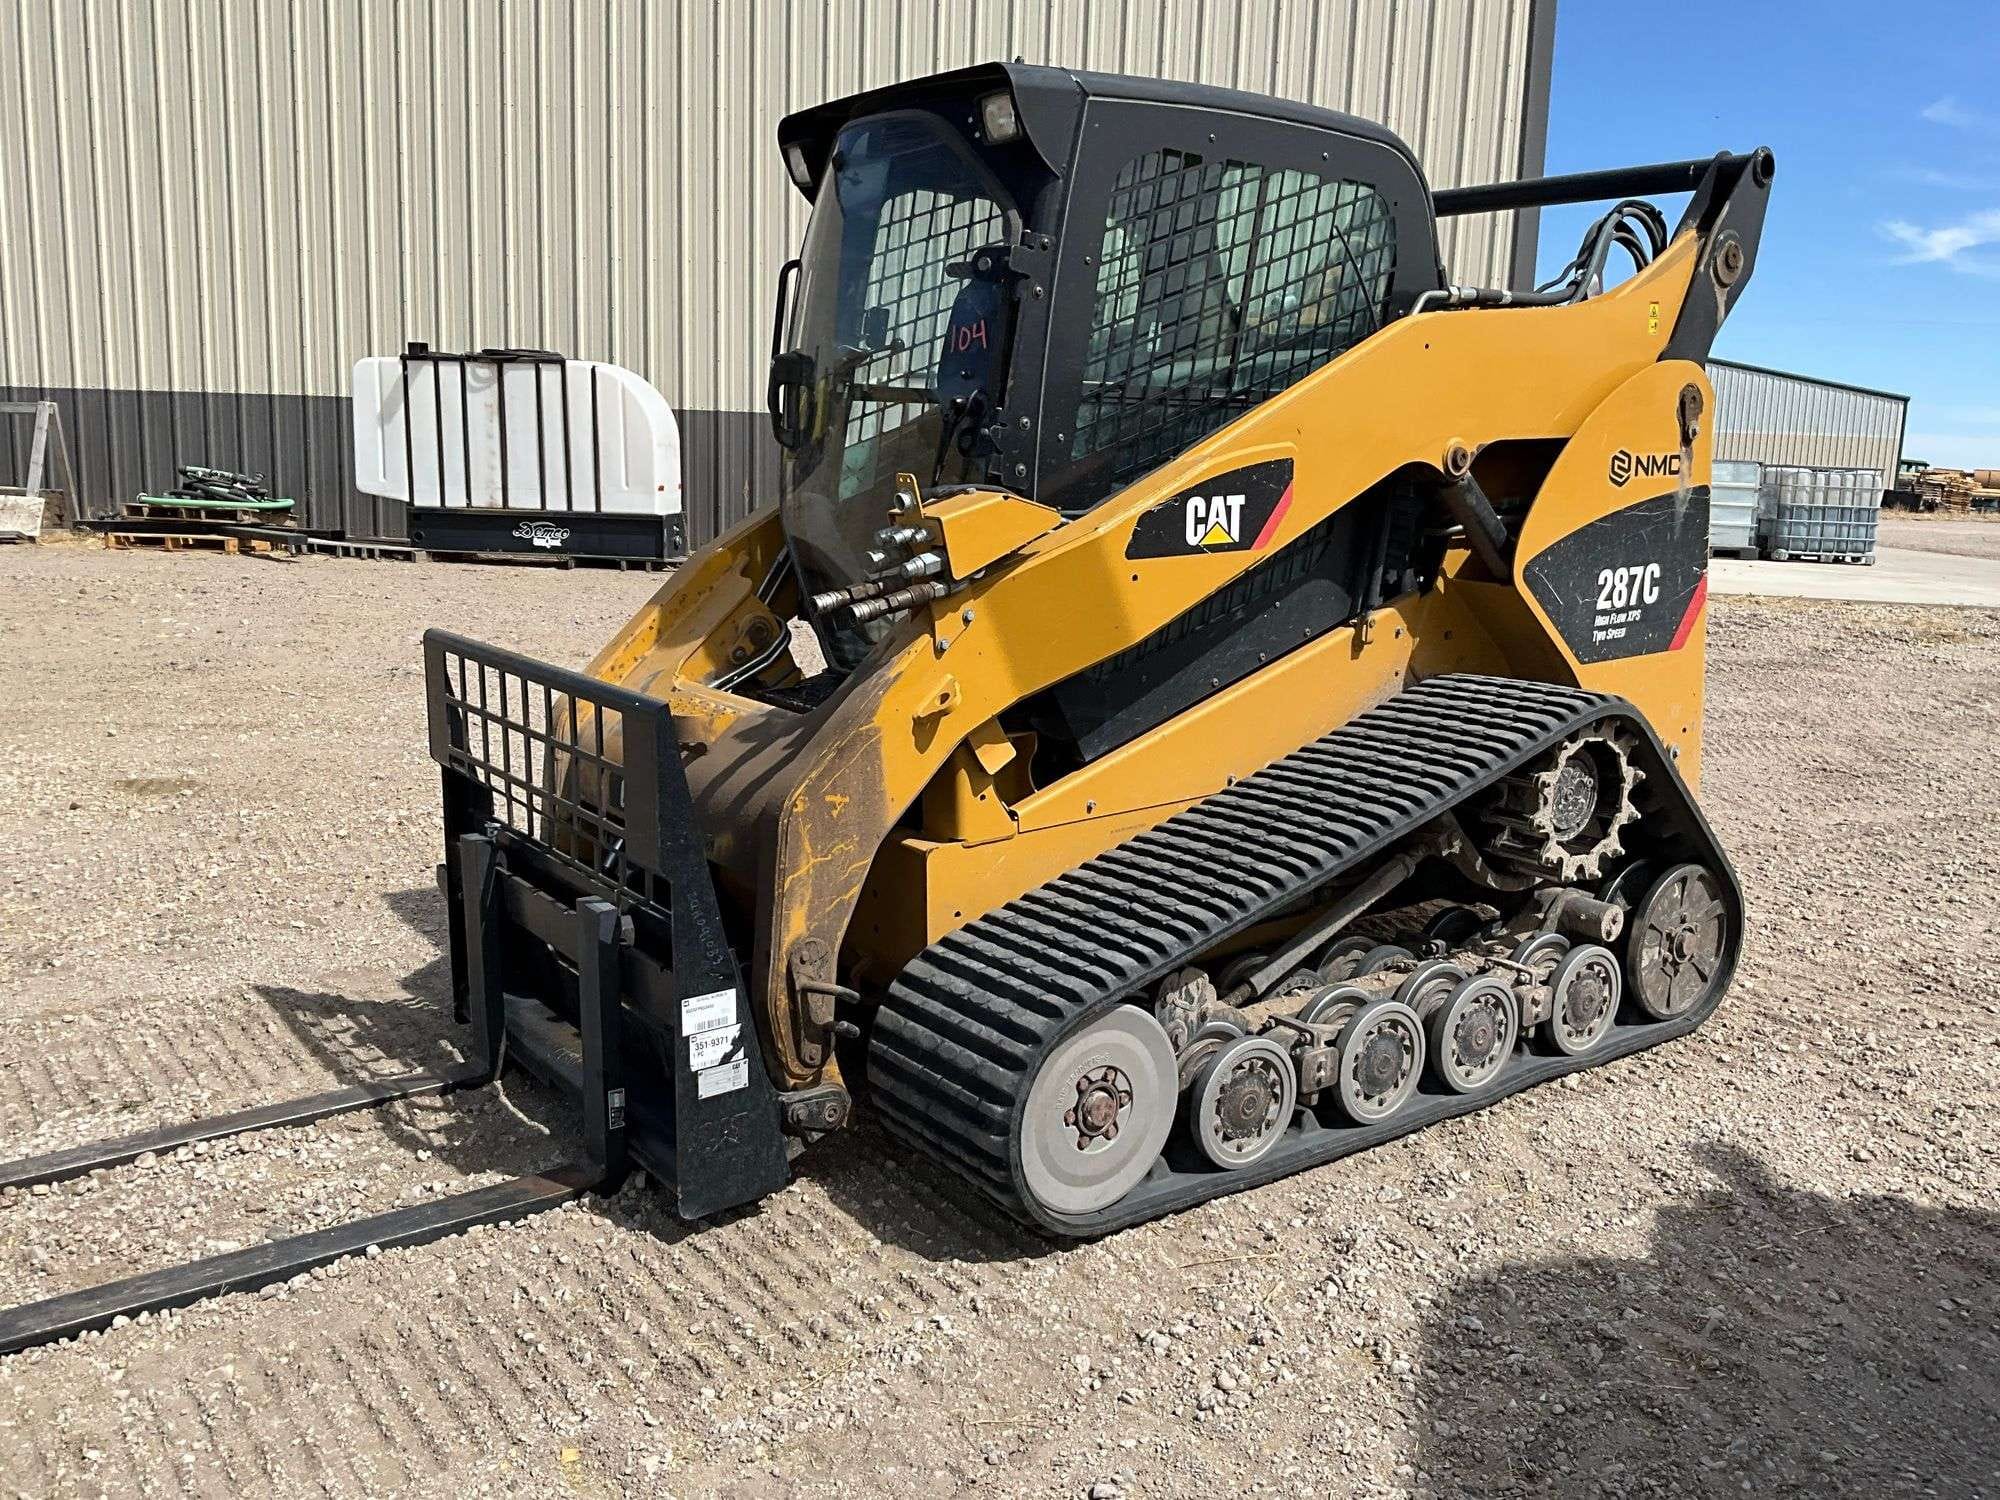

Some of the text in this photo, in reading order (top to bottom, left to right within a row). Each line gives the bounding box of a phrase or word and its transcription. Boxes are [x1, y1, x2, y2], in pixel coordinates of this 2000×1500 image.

[951, 320, 987, 352] 104
[512, 521, 570, 539] Demco
[1185, 494, 1246, 546] CAT
[1596, 563, 1660, 610] 287C
[1627, 610, 1641, 621] XPS
[695, 1036, 728, 1051] 351-9371
